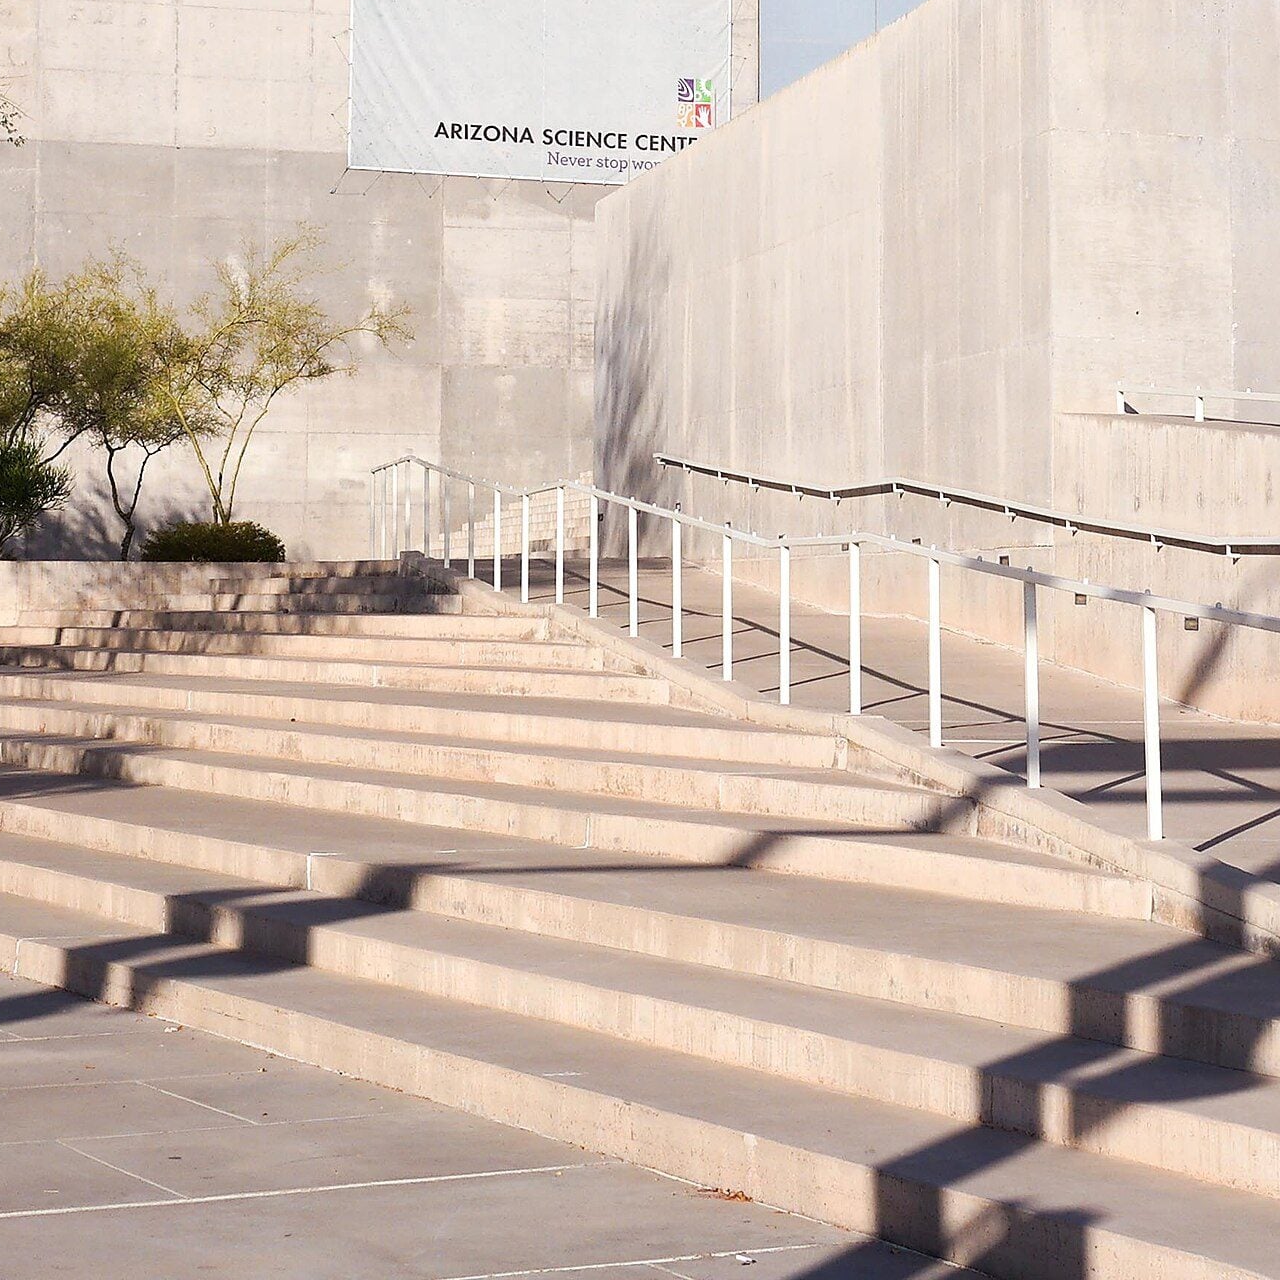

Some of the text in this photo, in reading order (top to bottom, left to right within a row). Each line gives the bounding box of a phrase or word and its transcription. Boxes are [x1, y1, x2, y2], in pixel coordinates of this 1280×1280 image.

[433, 121, 535, 144] ARIZONA
[542, 128, 628, 150] SCIENCE
[547, 151, 593, 168] Never
[596, 155, 629, 173] stop
